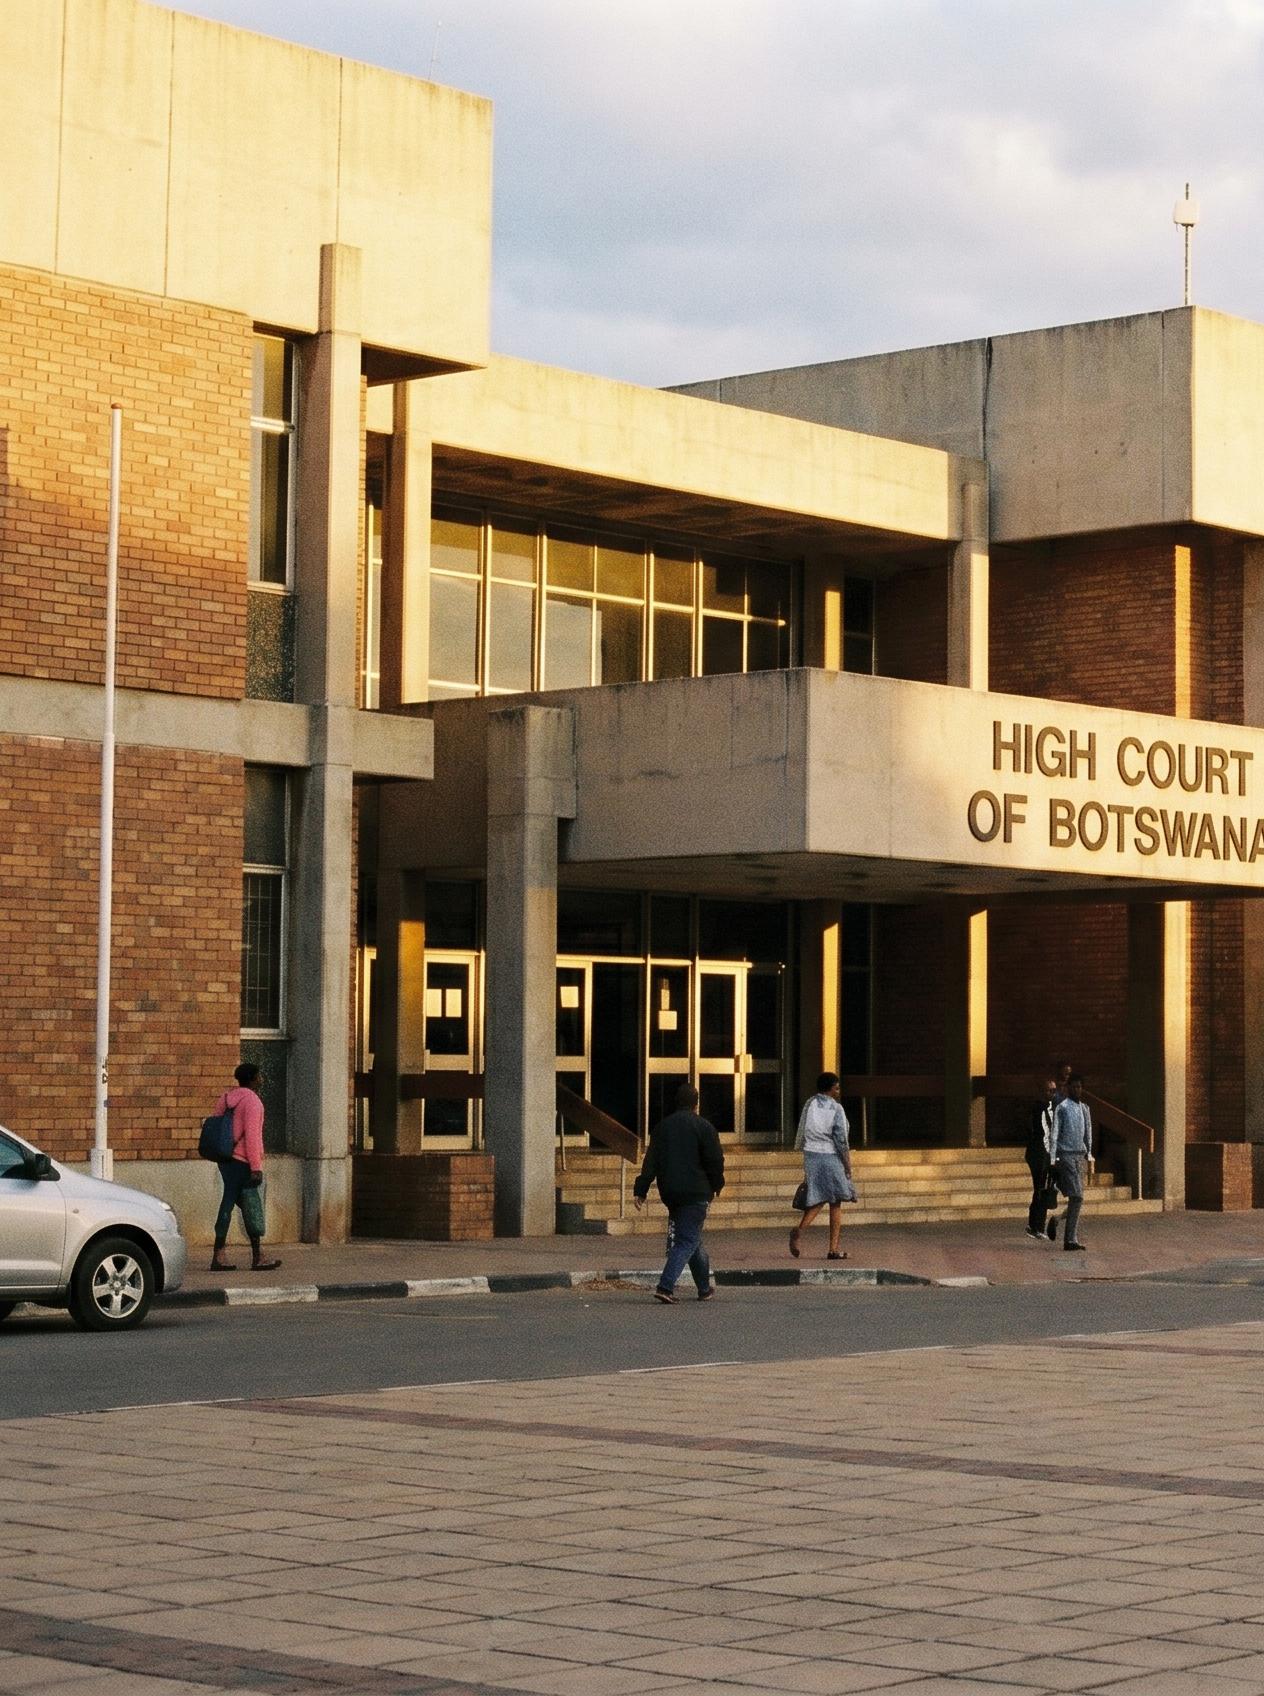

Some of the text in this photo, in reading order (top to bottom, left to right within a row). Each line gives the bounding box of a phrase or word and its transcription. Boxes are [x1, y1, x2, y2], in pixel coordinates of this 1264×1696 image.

[992, 720, 1254, 796] HIGH COURT
[967, 789, 1028, 844] OF
